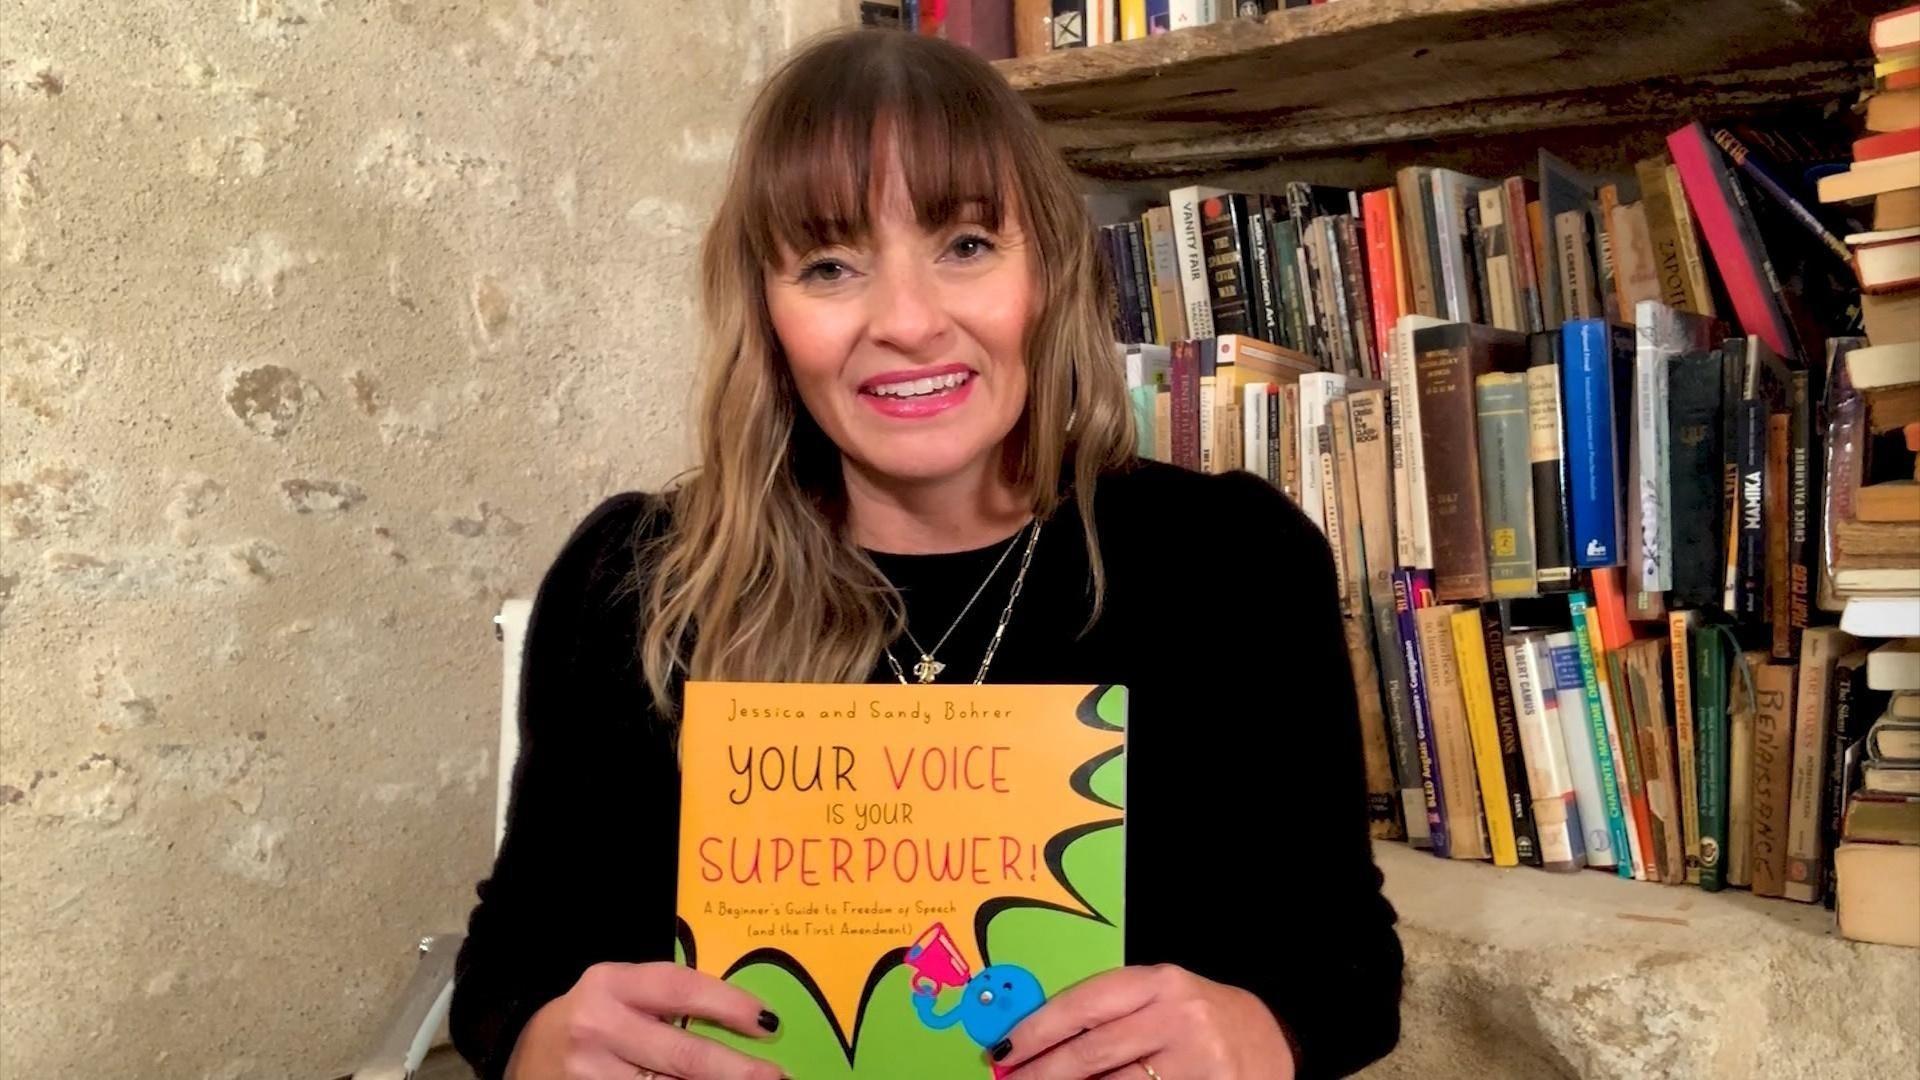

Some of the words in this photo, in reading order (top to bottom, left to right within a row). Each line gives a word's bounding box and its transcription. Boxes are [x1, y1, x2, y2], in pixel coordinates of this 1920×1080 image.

[1182, 202, 1198, 250] VANITY
[1252, 213, 1264, 248] Latin
[1189, 254, 1202, 281] FAIR
[1257, 248, 1272, 306] American
[1566, 253, 1578, 286] GREAT
[1265, 307, 1276, 327] Art
[1744, 471, 1761, 529] MAMIKA
[1794, 509, 1806, 543] CHUCK
[1394, 580, 1408, 613] BLED
[1672, 619, 1684, 637] Un
[1405, 639, 1419, 688] Conjugaison
[1426, 634, 1440, 687] literature
[1489, 630, 1506, 675] CHOICE
[1673, 641, 1686, 679] gusto
[1496, 677, 1509, 696] OF
[1519, 682, 1535, 716] CAMUS
[1839, 681, 1851, 702] The
[728, 698, 806, 722] Jessica
[820, 699, 857, 720] and
[869, 700, 931, 724] Sandy
[944, 700, 1014, 721] Bohrer
[1411, 694, 1426, 739] Grammaire
[1498, 697, 1516, 754] WEAPONS
[1675, 683, 1689, 740] superior
[1835, 702, 1850, 738] Silent
[728, 744, 857, 805] YOUR
[883, 745, 1012, 795] VOICE
[1418, 741, 1432, 779] Anglais
[1423, 780, 1436, 808] BLED
[826, 803, 845, 825] IS
[855, 803, 914, 831] YOUR
[699, 835, 1038, 887] SUPERPOWER!
[703, 901, 714, 916] A
[717, 901, 781, 919] Beginner's
[785, 901, 820, 917] Guide
[825, 901, 837, 916] to
[842, 901, 895, 916] Freedom
[897, 904, 910, 919] of
[914, 900, 958, 917] Speech
[747, 923, 777, 938] (and
[780, 923, 800, 936] the
[805, 923, 837, 936] First
[840, 923, 914, 938] Amendment)
